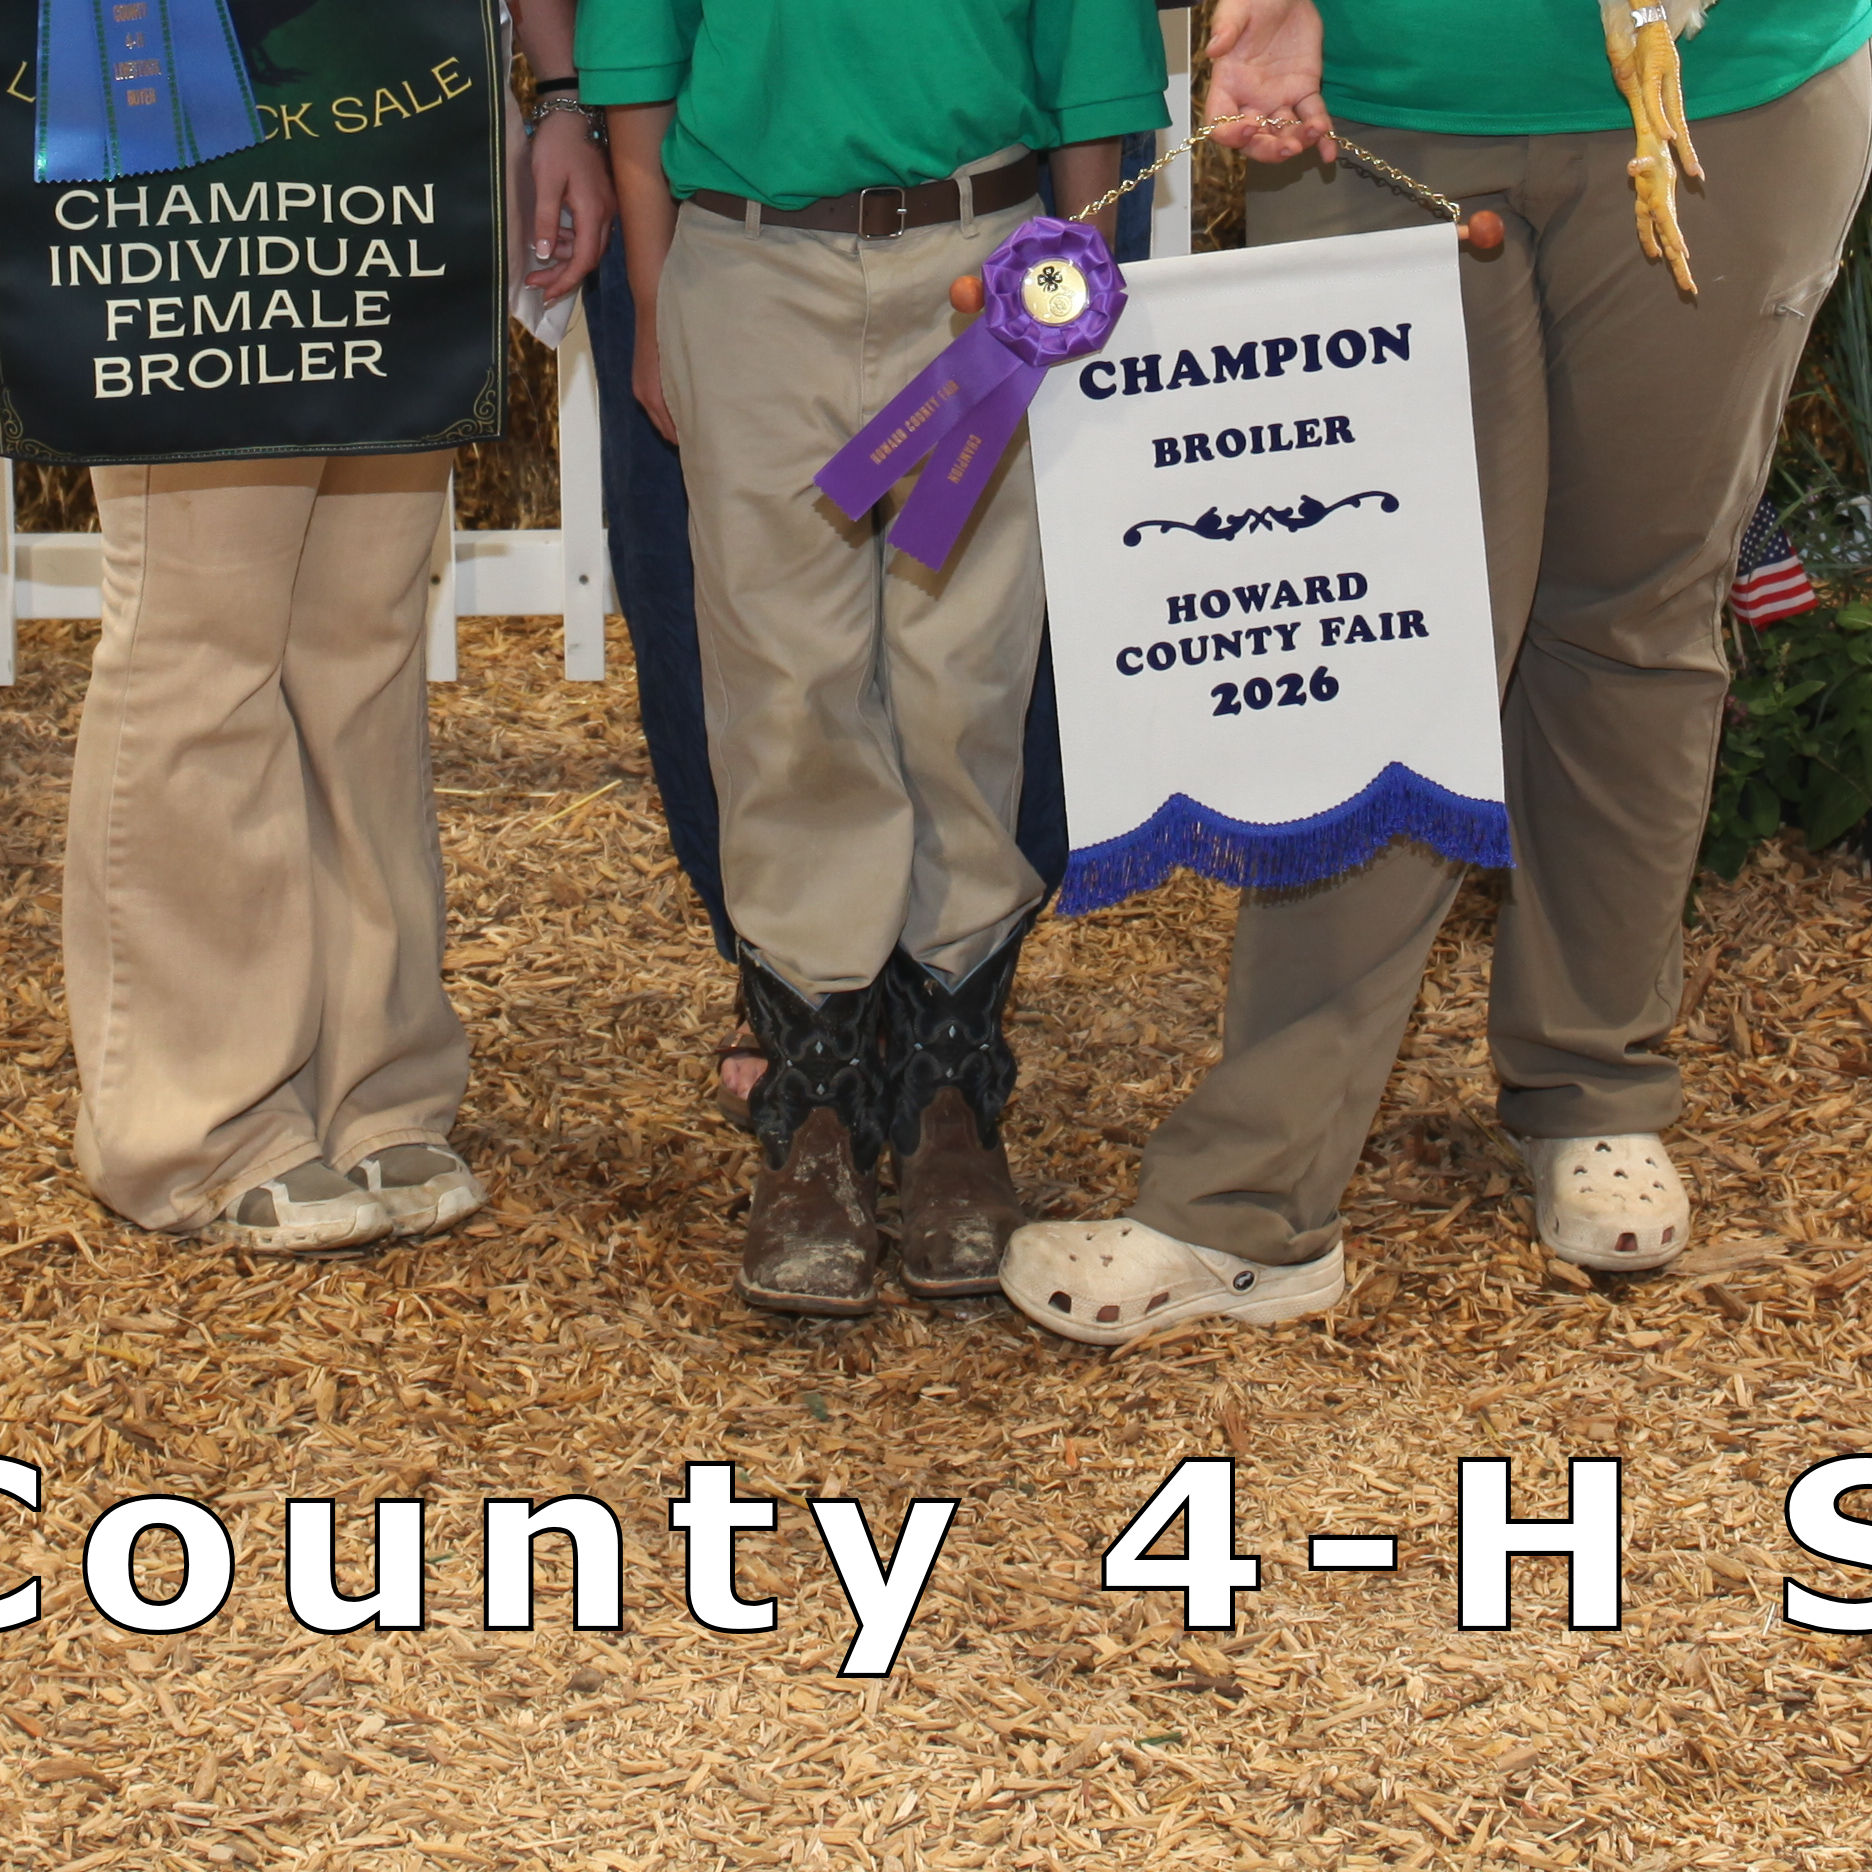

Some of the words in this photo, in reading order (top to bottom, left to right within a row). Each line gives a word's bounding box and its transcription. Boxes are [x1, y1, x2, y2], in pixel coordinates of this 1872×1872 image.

[331, 55, 473, 135] SALE
[54, 181, 435, 231] CHAMPION
[49, 236, 447, 287] INDIVIDUAL
[104, 289, 392, 341] FEMALE
[93, 338, 387, 399] BROILER
[1078, 322, 1414, 400] CHAMPION
[869, 428, 908, 465] HOWARD
[904, 396, 941, 432] COUNTY
[1152, 415, 1356, 469] BROILER
[947, 434, 983, 484] CHAMPION
[1166, 570, 1369, 625] HOWARD
[1115, 622, 1302, 676] COUNTY
[1320, 609, 1429, 648] FAIR
[1210, 666, 1340, 717] 2026
